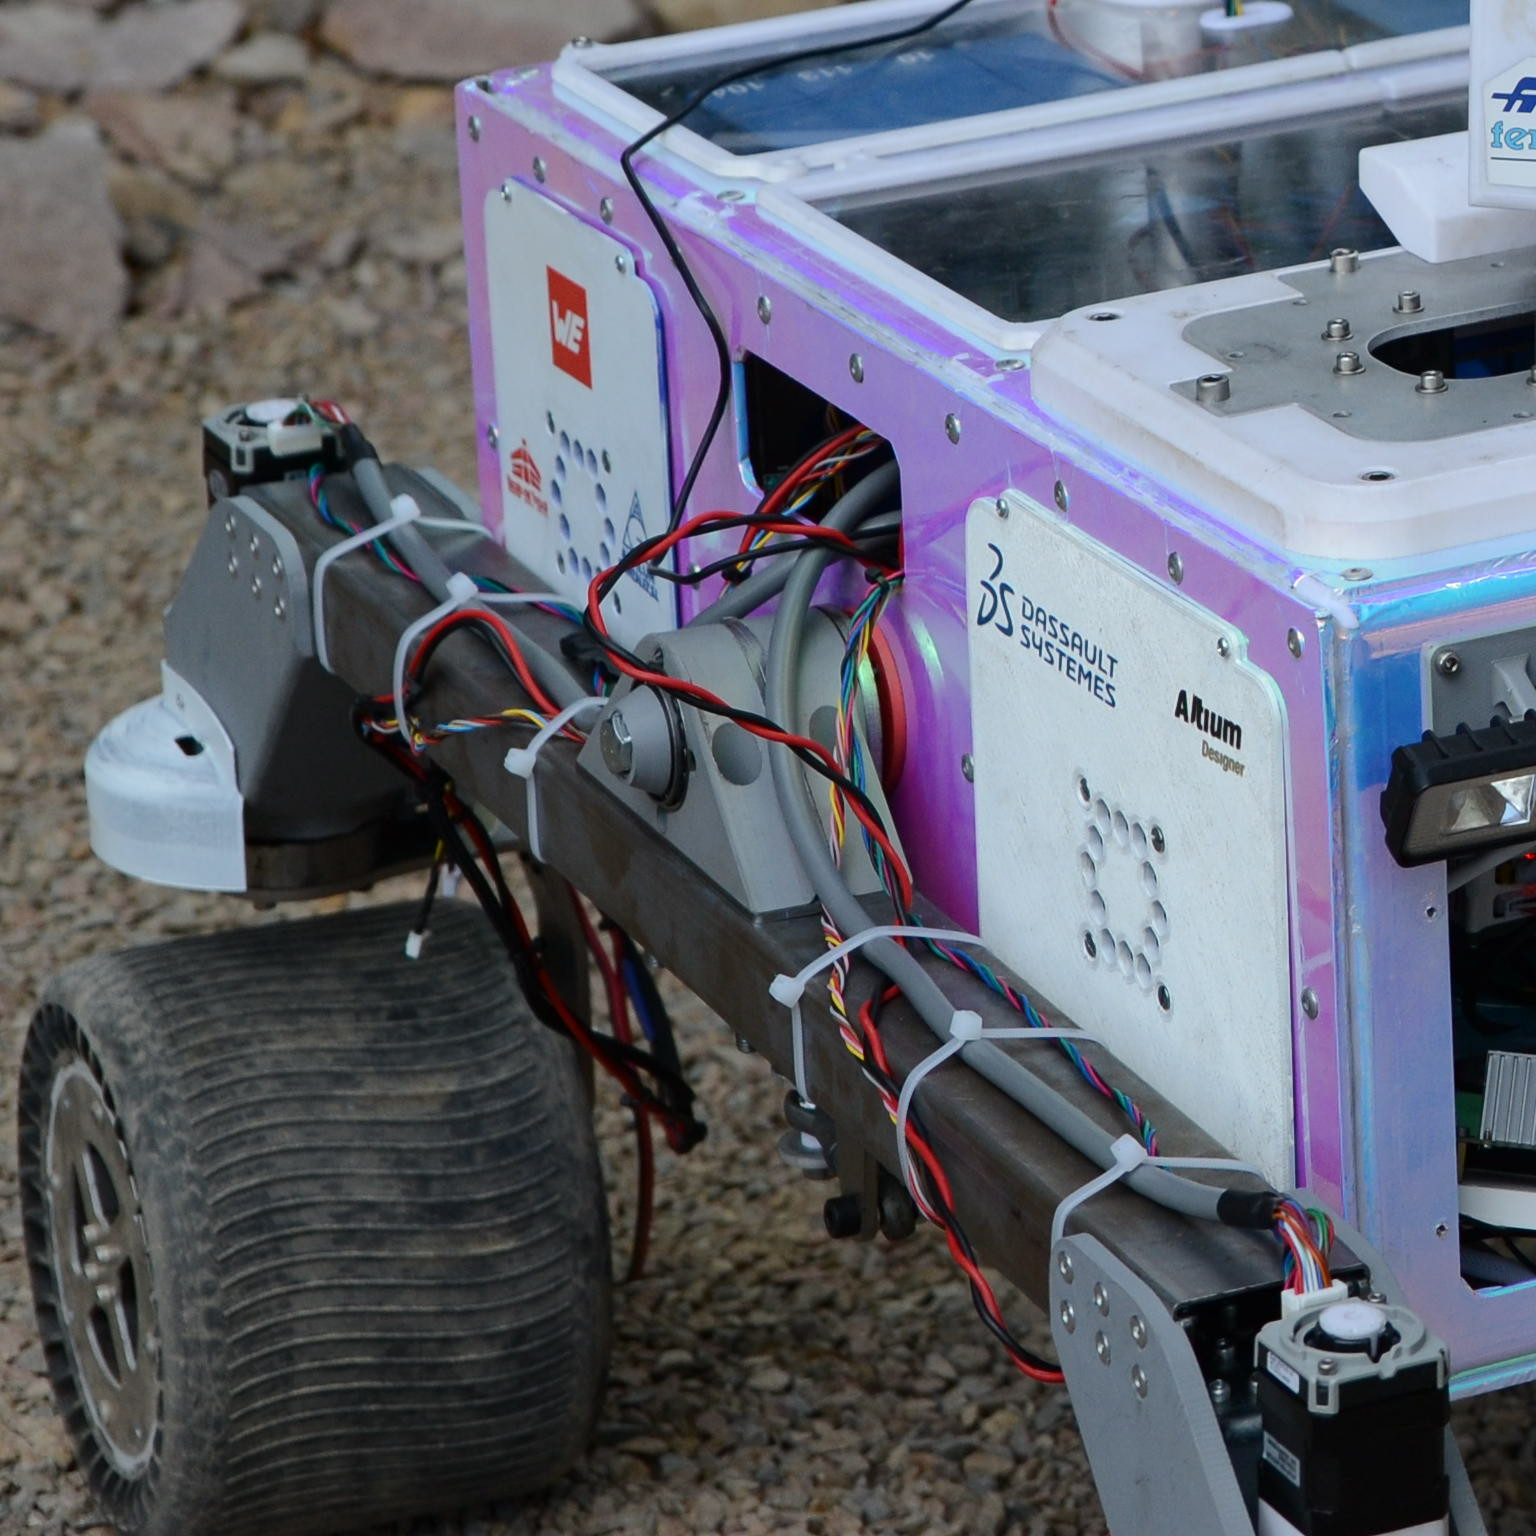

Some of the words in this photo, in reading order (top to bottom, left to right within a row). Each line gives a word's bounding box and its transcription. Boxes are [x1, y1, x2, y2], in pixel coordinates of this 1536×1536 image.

[551, 299, 586, 355] WE
[1020, 624, 1117, 708] SYSTEMES
[1022, 595, 1118, 678] DASSAULT
[1174, 689, 1242, 750] Altium
[1201, 739, 1246, 777] Designer
